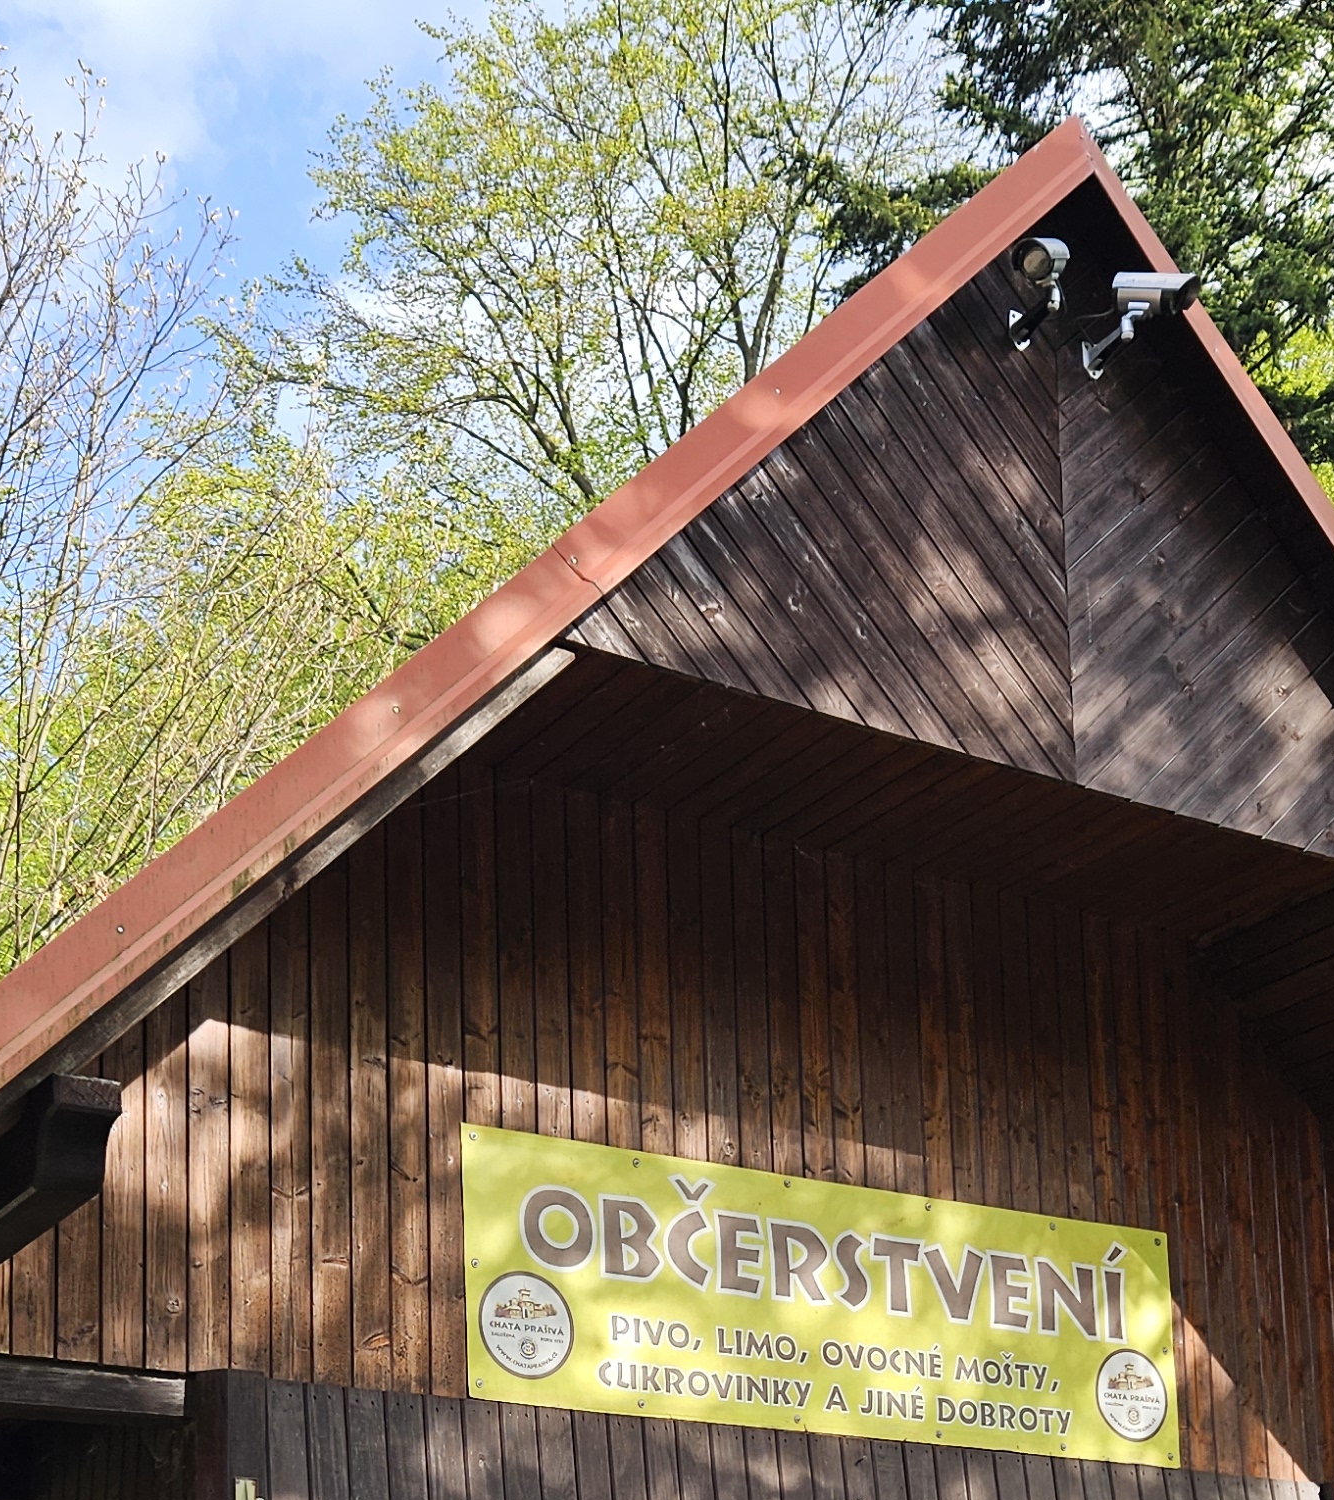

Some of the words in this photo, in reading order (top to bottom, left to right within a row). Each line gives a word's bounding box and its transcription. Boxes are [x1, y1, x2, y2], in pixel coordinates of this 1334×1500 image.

[519, 1174, 1128, 1345] OBČERSTVENÍ
[490, 1321, 521, 1332] CHATA
[524, 1324, 564, 1336] PRAŠIVÁ
[610, 1314, 702, 1354] PIVO,
[716, 1326, 808, 1366] LIMO,
[822, 1341, 945, 1380] OVOCNÉ
[955, 1351, 1060, 1394] MOŠTY,
[597, 1361, 812, 1410] CUKROVINKY
[825, 1385, 849, 1414] A
[860, 1381, 926, 1421] JINÉ
[936, 1396, 1071, 1436] DOBROTY
